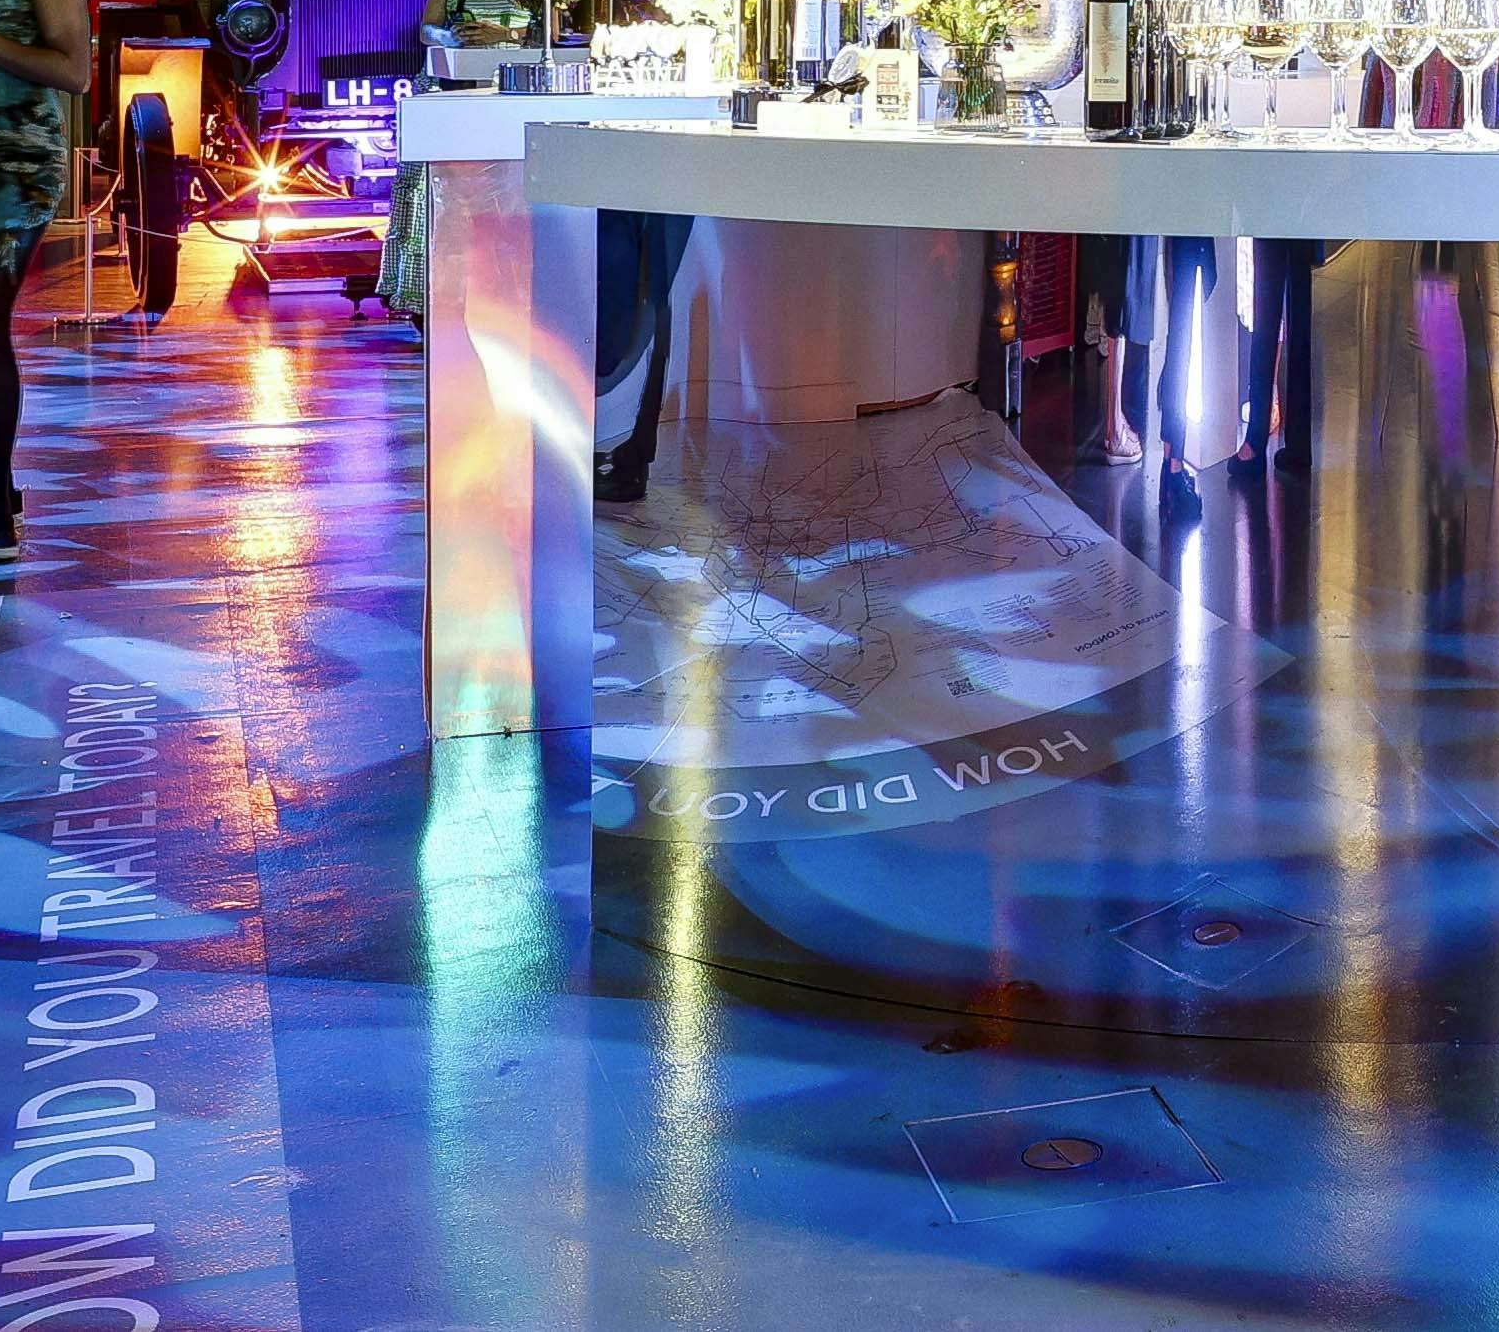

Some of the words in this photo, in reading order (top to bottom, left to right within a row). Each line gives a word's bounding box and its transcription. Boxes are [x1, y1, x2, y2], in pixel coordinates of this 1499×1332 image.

[57, 682, 159, 794] TODAY?
[39, 789, 158, 941] TRAVEL
[23, 948, 160, 1072] YOU
[6, 1078, 157, 1203] DID
